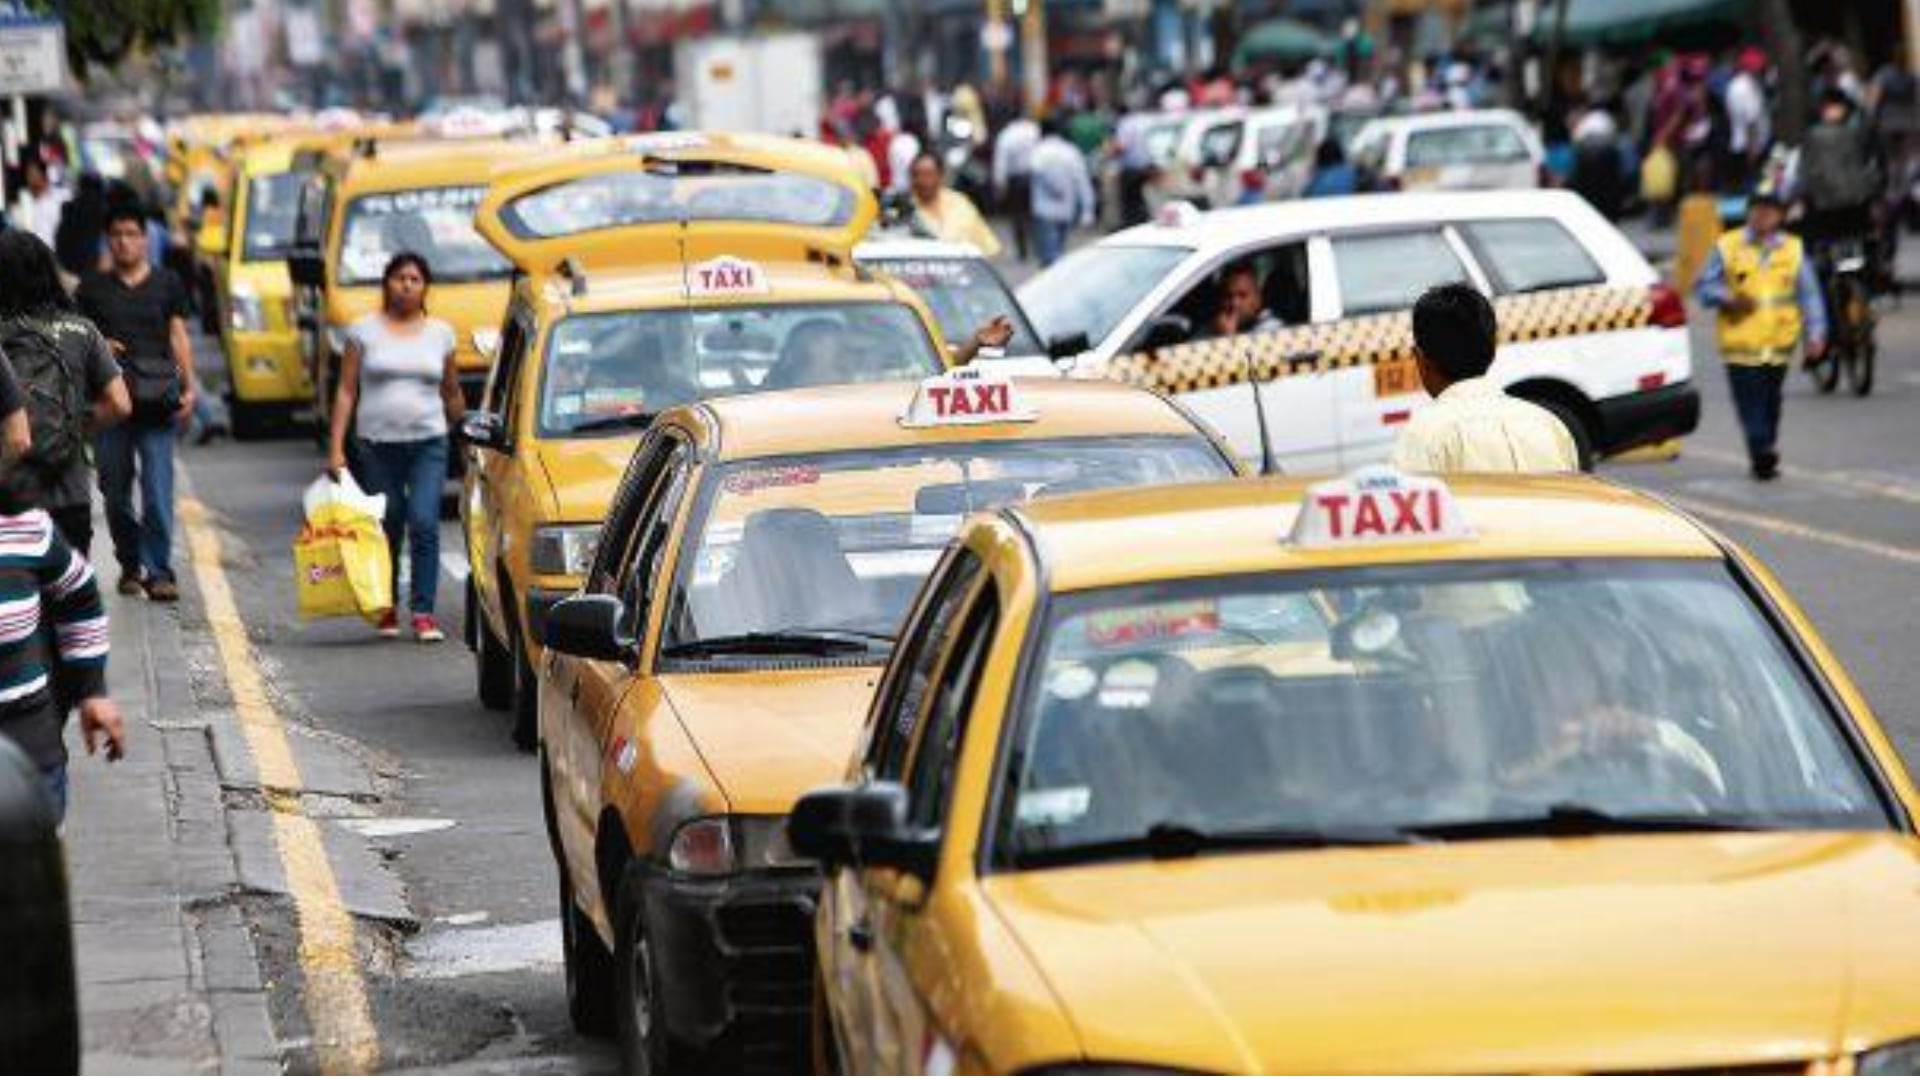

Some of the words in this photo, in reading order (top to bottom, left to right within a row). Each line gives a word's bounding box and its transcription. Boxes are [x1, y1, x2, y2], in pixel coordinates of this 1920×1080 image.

[699, 267, 754, 290] TAXI
[927, 384, 1008, 417] TAXI
[1317, 489, 1440, 538] TAXI
